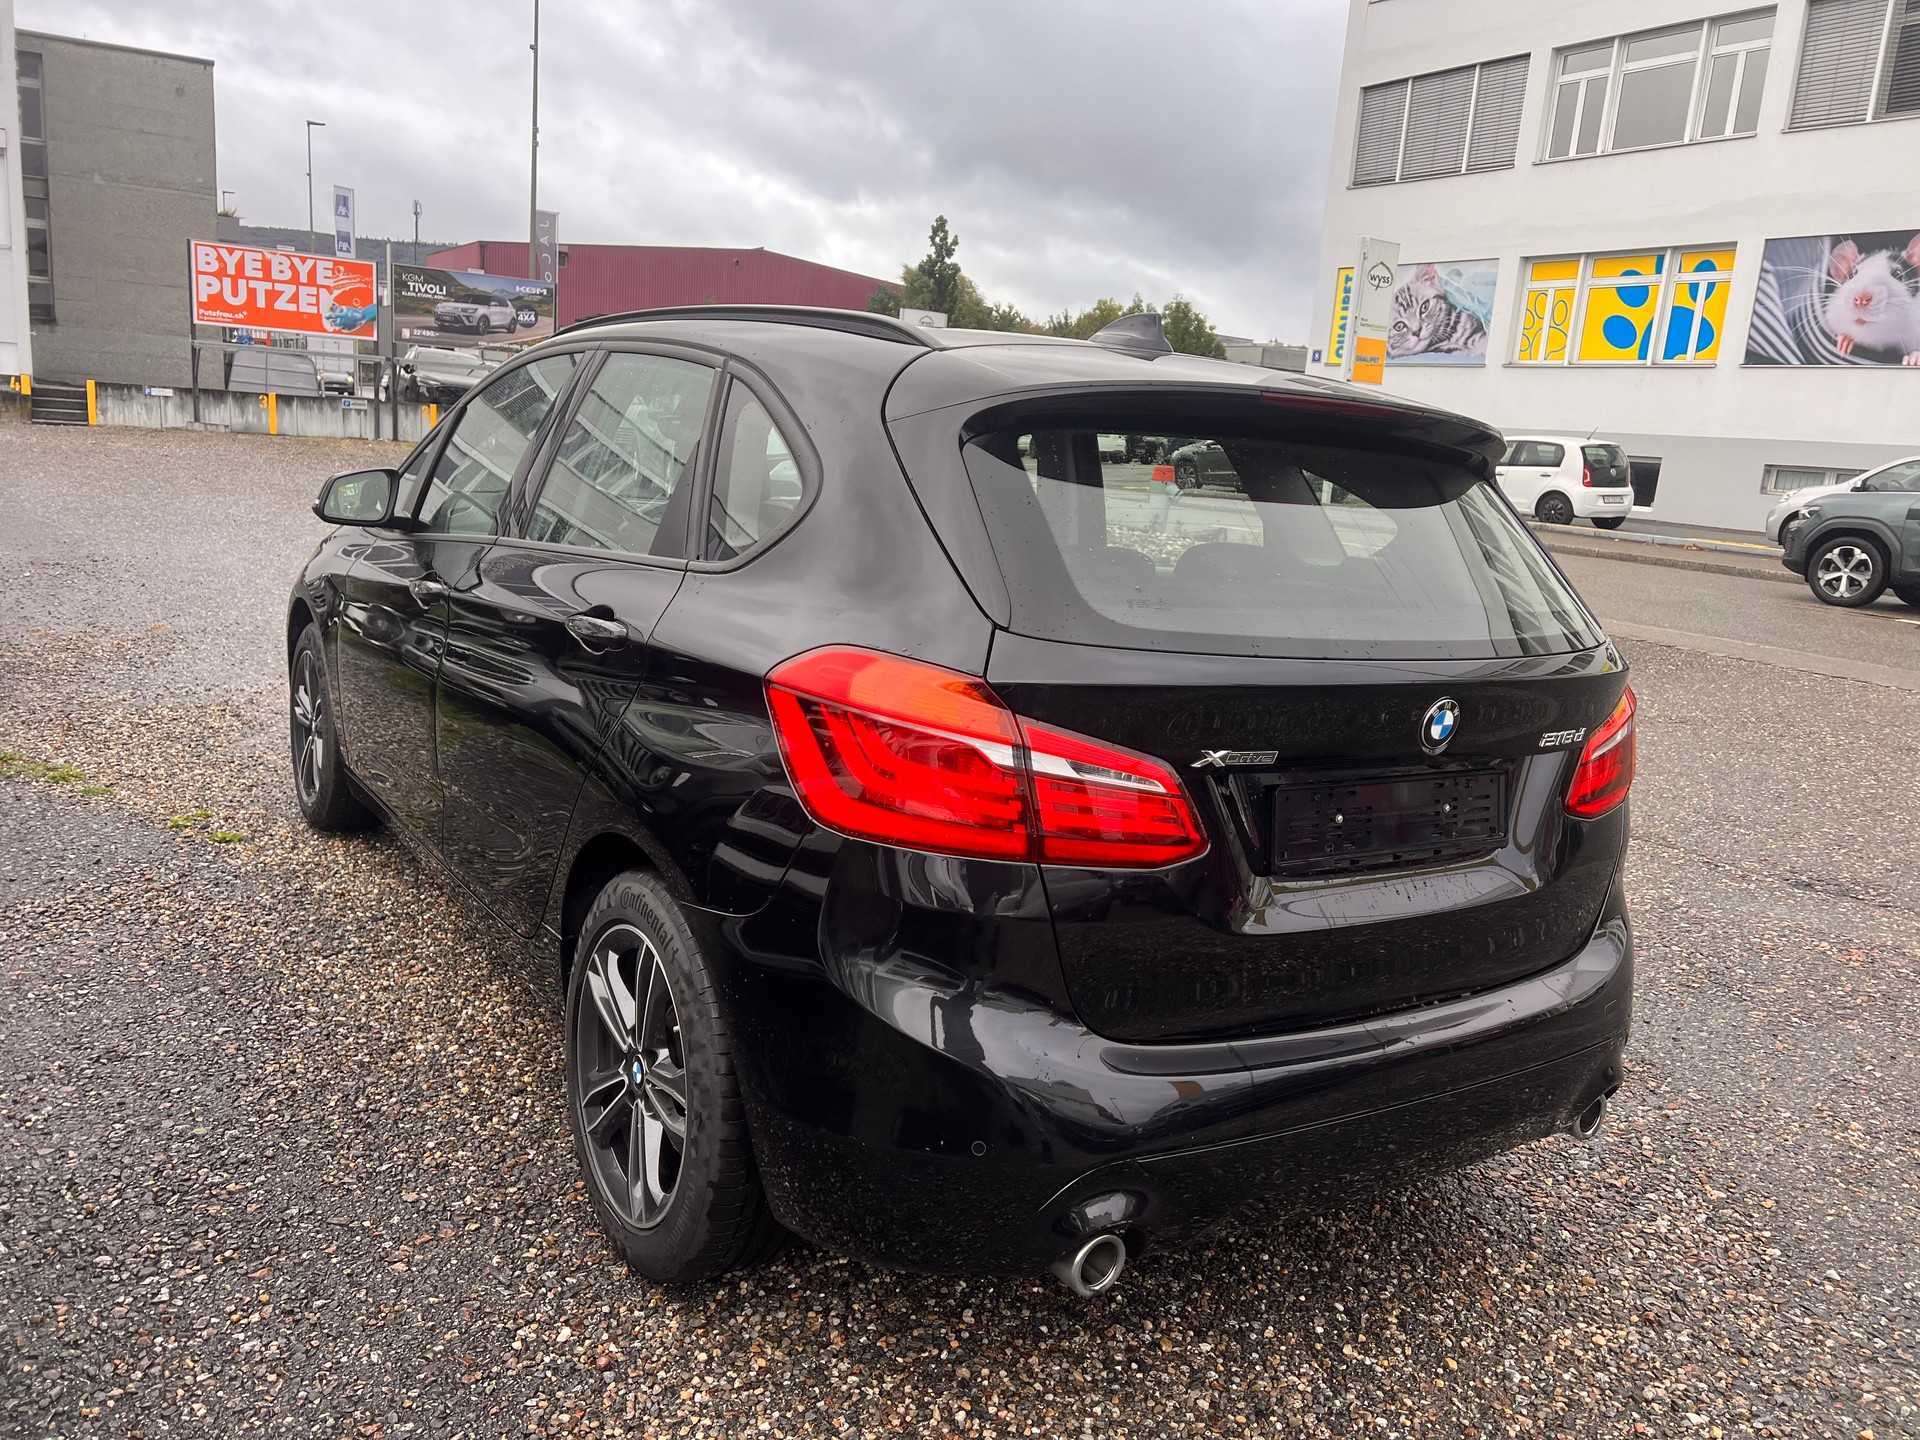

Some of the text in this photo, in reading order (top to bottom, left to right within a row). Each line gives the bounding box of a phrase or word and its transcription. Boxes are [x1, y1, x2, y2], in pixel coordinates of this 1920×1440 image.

[198, 246, 334, 286] BYE BYE
[402, 273, 424, 282] KGM
[407, 282, 446, 295] TIVOLI
[516, 286, 547, 295] KGM
[258, 394, 268, 408] 3
[421, 405, 430, 417] 2
[1431, 701, 1460, 717] BMW
[620, 886, 674, 952] Continental
